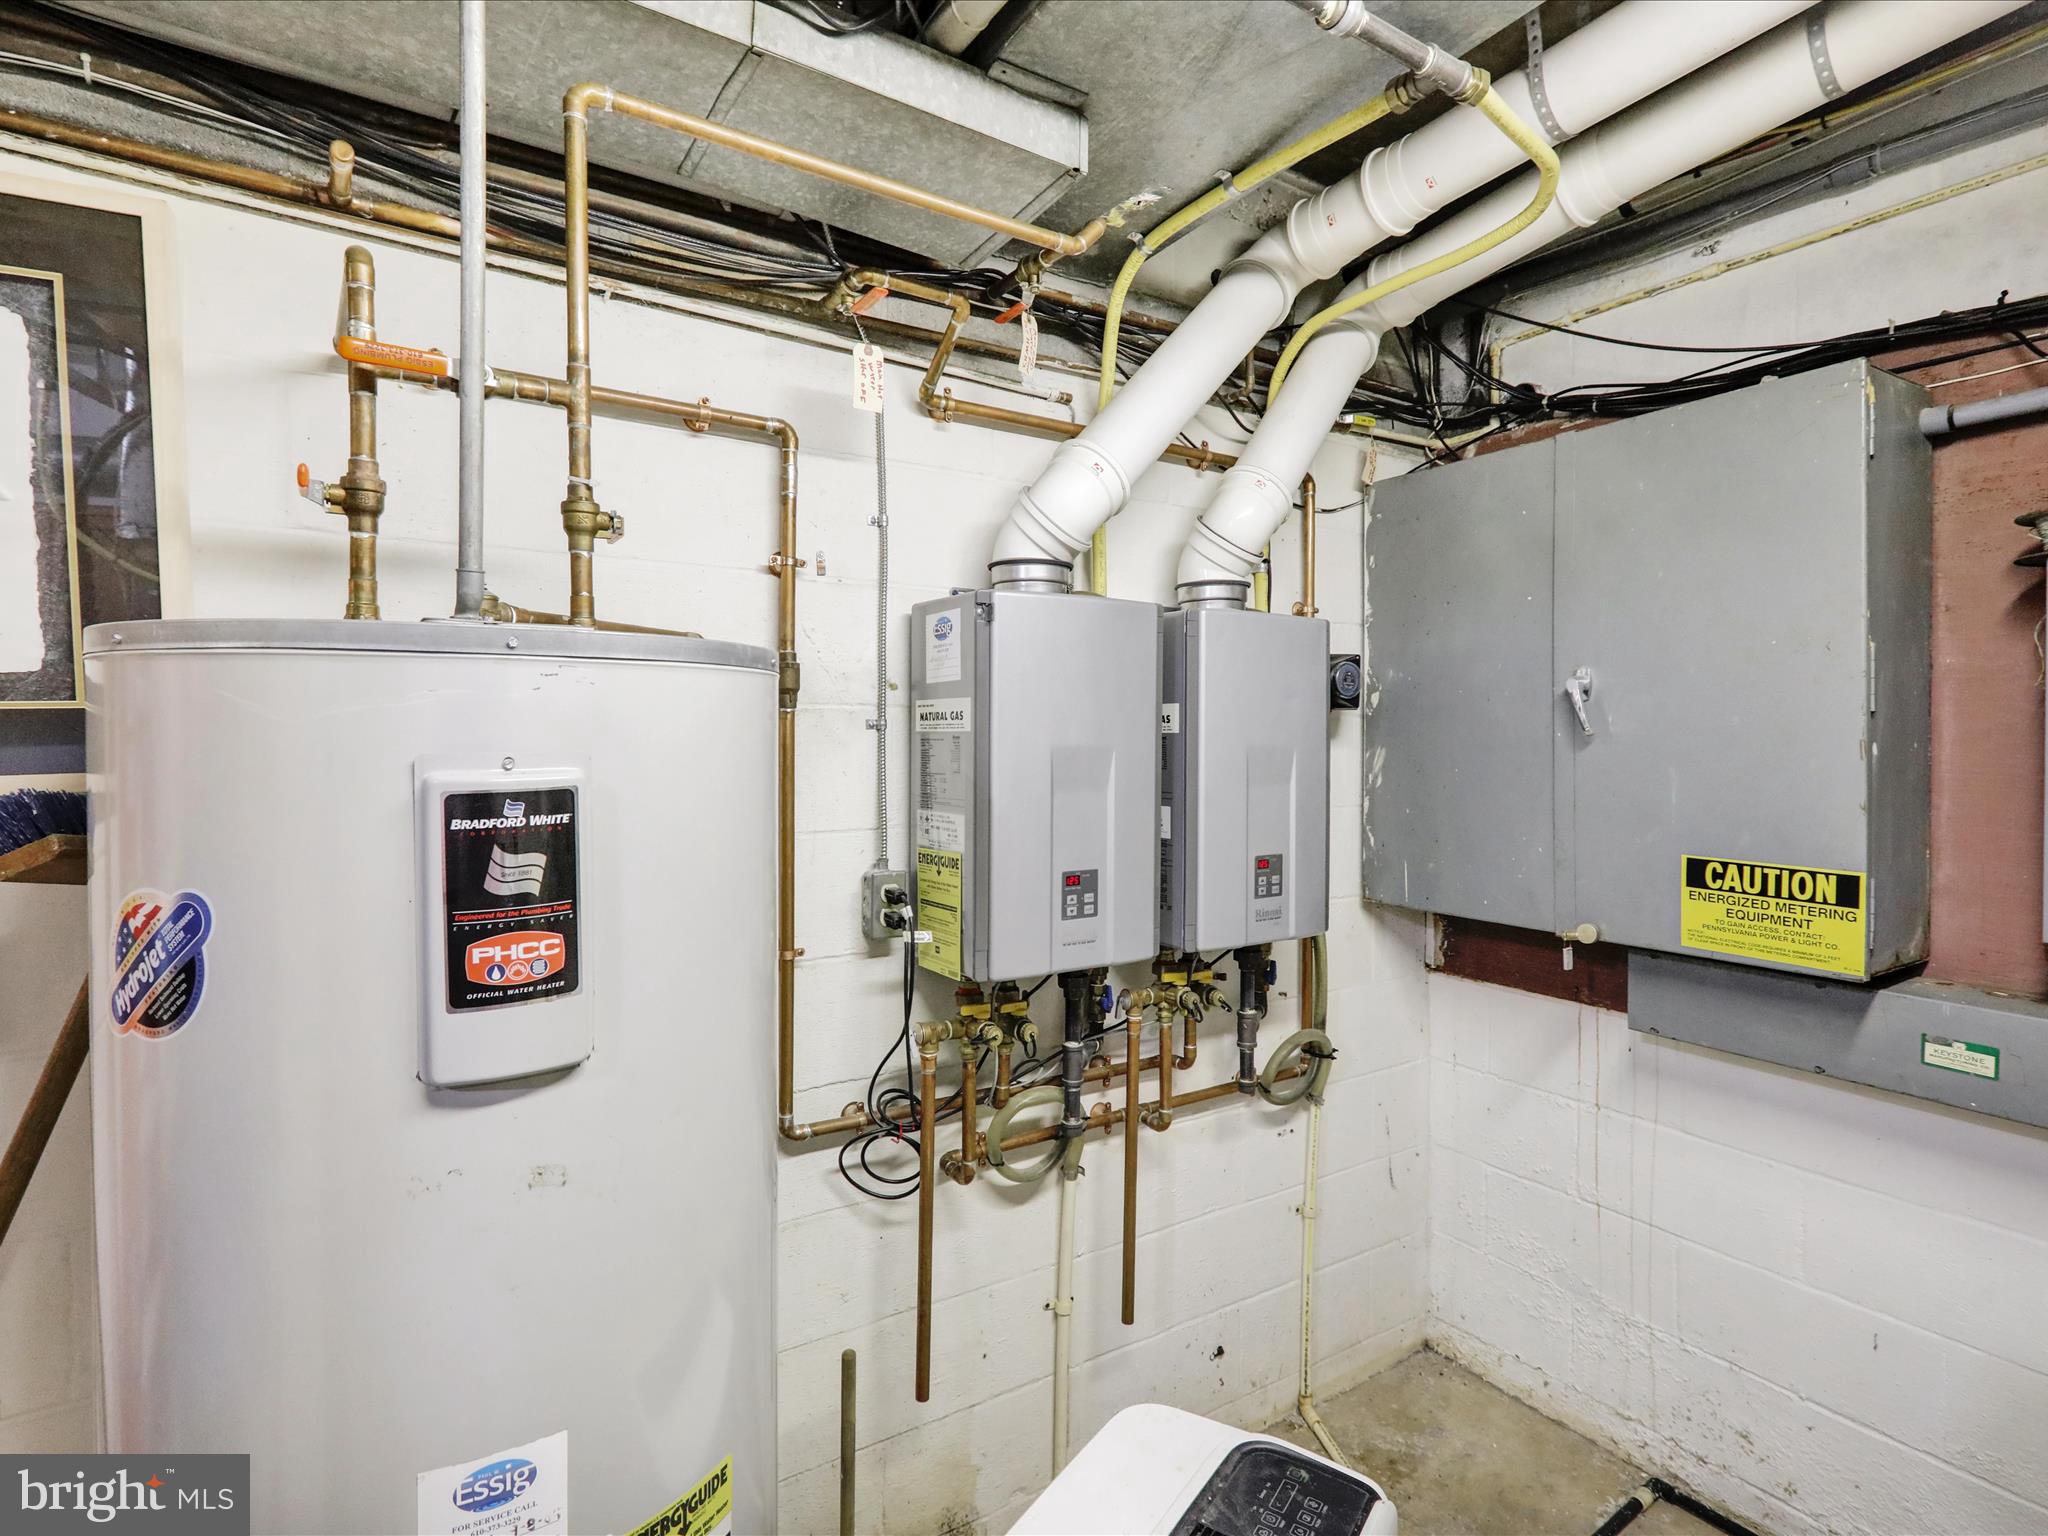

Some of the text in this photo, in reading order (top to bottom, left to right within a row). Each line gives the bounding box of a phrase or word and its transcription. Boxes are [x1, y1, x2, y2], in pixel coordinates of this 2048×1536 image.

[919, 710, 964, 721] NATURAL GAS
[450, 813, 570, 831] BRADFORD WHITE
[1705, 862, 1837, 904] CAUTION
[454, 912, 495, 921] Engineered
[521, 905, 552, 916] Plumbing
[553, 903, 572, 911] Trade
[1689, 890, 1857, 922] ENERGIZED METERING
[453, 914, 573, 932] ENERGY SAVER
[1726, 908, 1814, 930] EQUIPMENT
[1727, 921, 1745, 929] GAIN
[167, 930, 185, 952] SYSTEM
[1702, 923, 1758, 938] PENNSYLVANIA
[1759, 932, 1789, 942] POWER
[1798, 939, 1823, 948] LIGHT
[472, 938, 561, 964] PHCC
[115, 939, 166, 1017] Hydrojet
[466, 981, 565, 1000] OFFICIAL WATER HEATER
[1933, 1047, 1986, 1065] KEYSTONE
[456, 1463, 535, 1506] Essig
[452, 1523, 471, 1534] FOR
[473, 1510, 513, 1528] SERVICE
[514, 1501, 538, 1514] CALL
